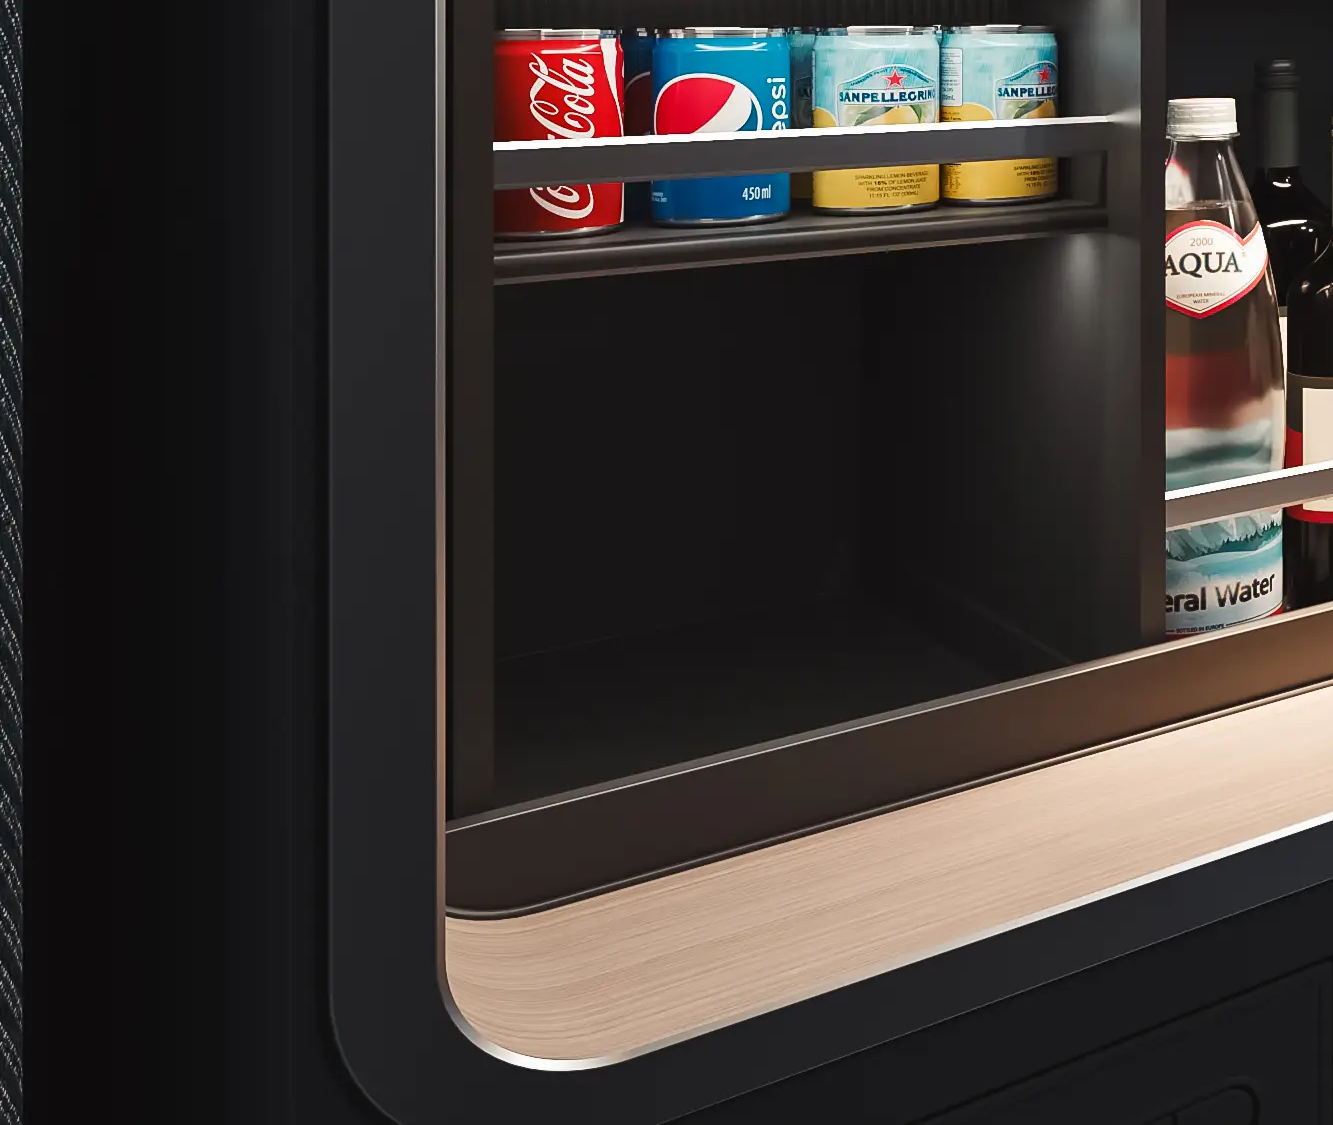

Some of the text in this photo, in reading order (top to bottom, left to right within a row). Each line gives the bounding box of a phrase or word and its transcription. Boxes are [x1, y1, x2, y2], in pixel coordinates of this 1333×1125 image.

[767, 77, 789, 131] epsi
[839, 89, 936, 103] SANPELLEGRINO
[742, 184, 772, 201] 450 ml
[1190, 237, 1214, 247] 2000
[1166, 251, 1242, 278] AQUA
[1215, 573, 1275, 608] Water
